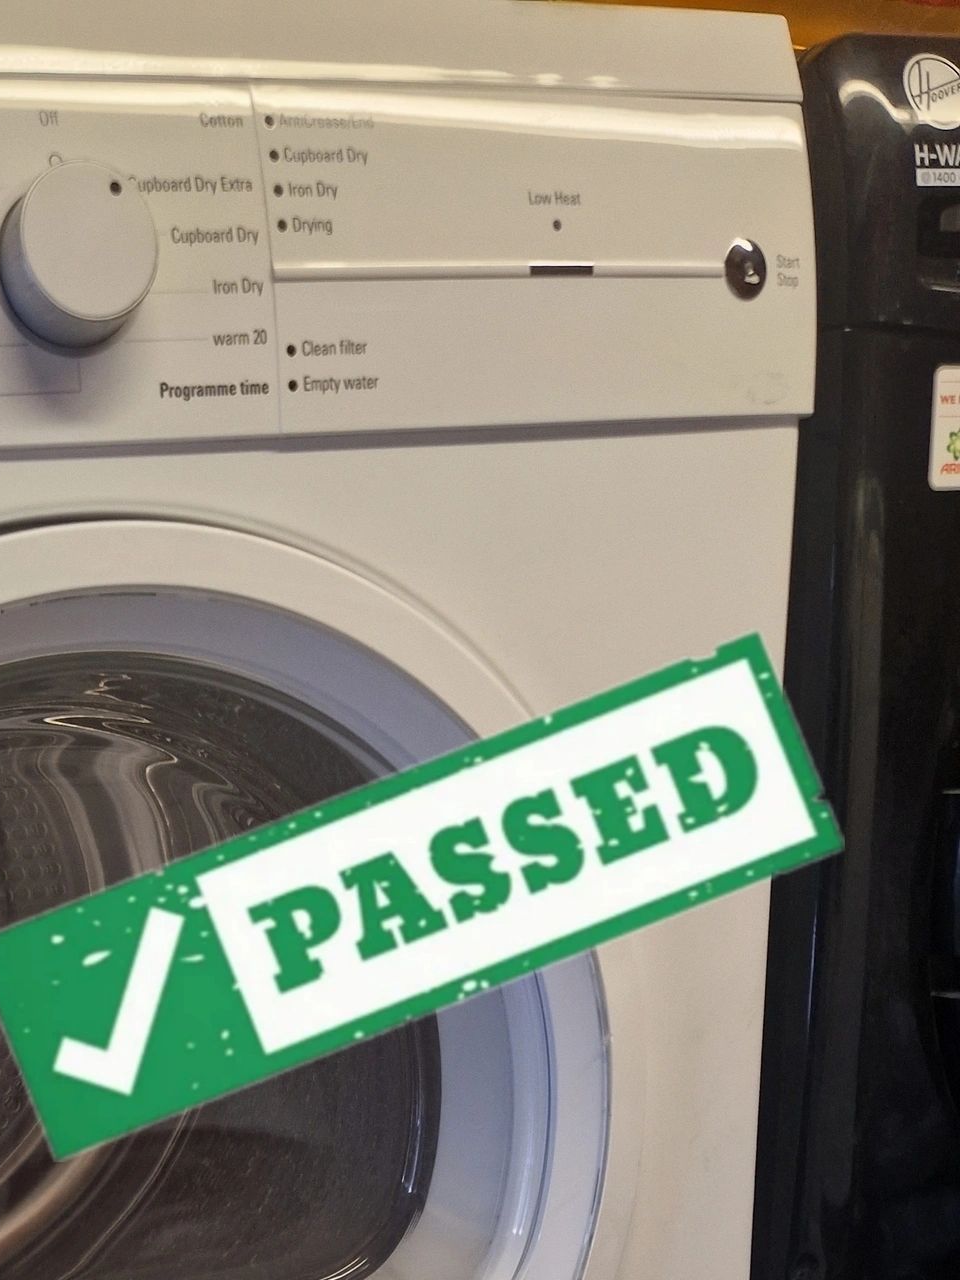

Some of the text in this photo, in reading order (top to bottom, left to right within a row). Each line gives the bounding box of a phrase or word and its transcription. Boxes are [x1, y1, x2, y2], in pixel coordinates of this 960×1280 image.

[39, 109, 60, 127] Off
[199, 112, 244, 128] Cotton
[283, 147, 368, 166] Cupboard Dry
[128, 176, 253, 195] upboard Dry Extra
[288, 182, 338, 201] Iron Dry
[528, 190, 582, 206] Low Heat
[292, 217, 333, 235] Drying
[170, 226, 259, 246] Cupboard Dry
[776, 254, 800, 270] Start
[212, 278, 264, 296] Iron Dry
[777, 273, 799, 289] Stop
[213, 329, 267, 347] warm 20
[301, 340, 368, 357] Clean filter
[159, 381, 270, 400] Programme time
[303, 376, 379, 394] Empty water
